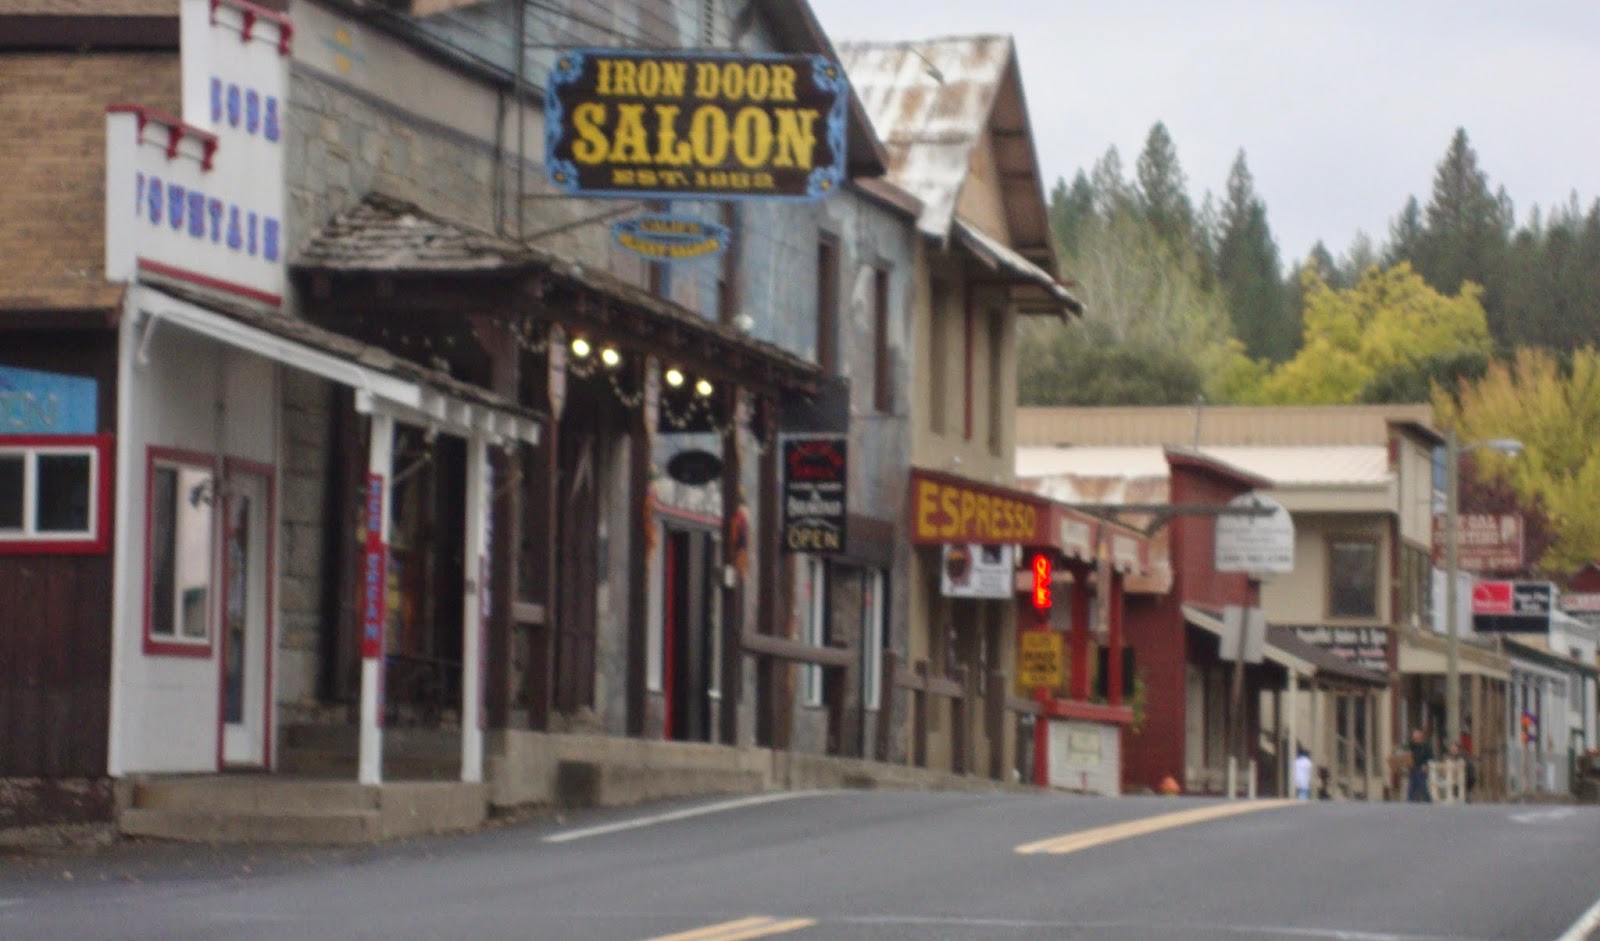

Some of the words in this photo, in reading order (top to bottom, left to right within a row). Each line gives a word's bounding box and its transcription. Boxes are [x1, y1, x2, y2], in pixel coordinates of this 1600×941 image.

[597, 59, 687, 97] IRON
[695, 62, 797, 101] DOOR
[572, 102, 819, 170] SALOON
[918, 478, 1037, 540] ESPRESSO
[787, 527, 840, 550] OPEN
